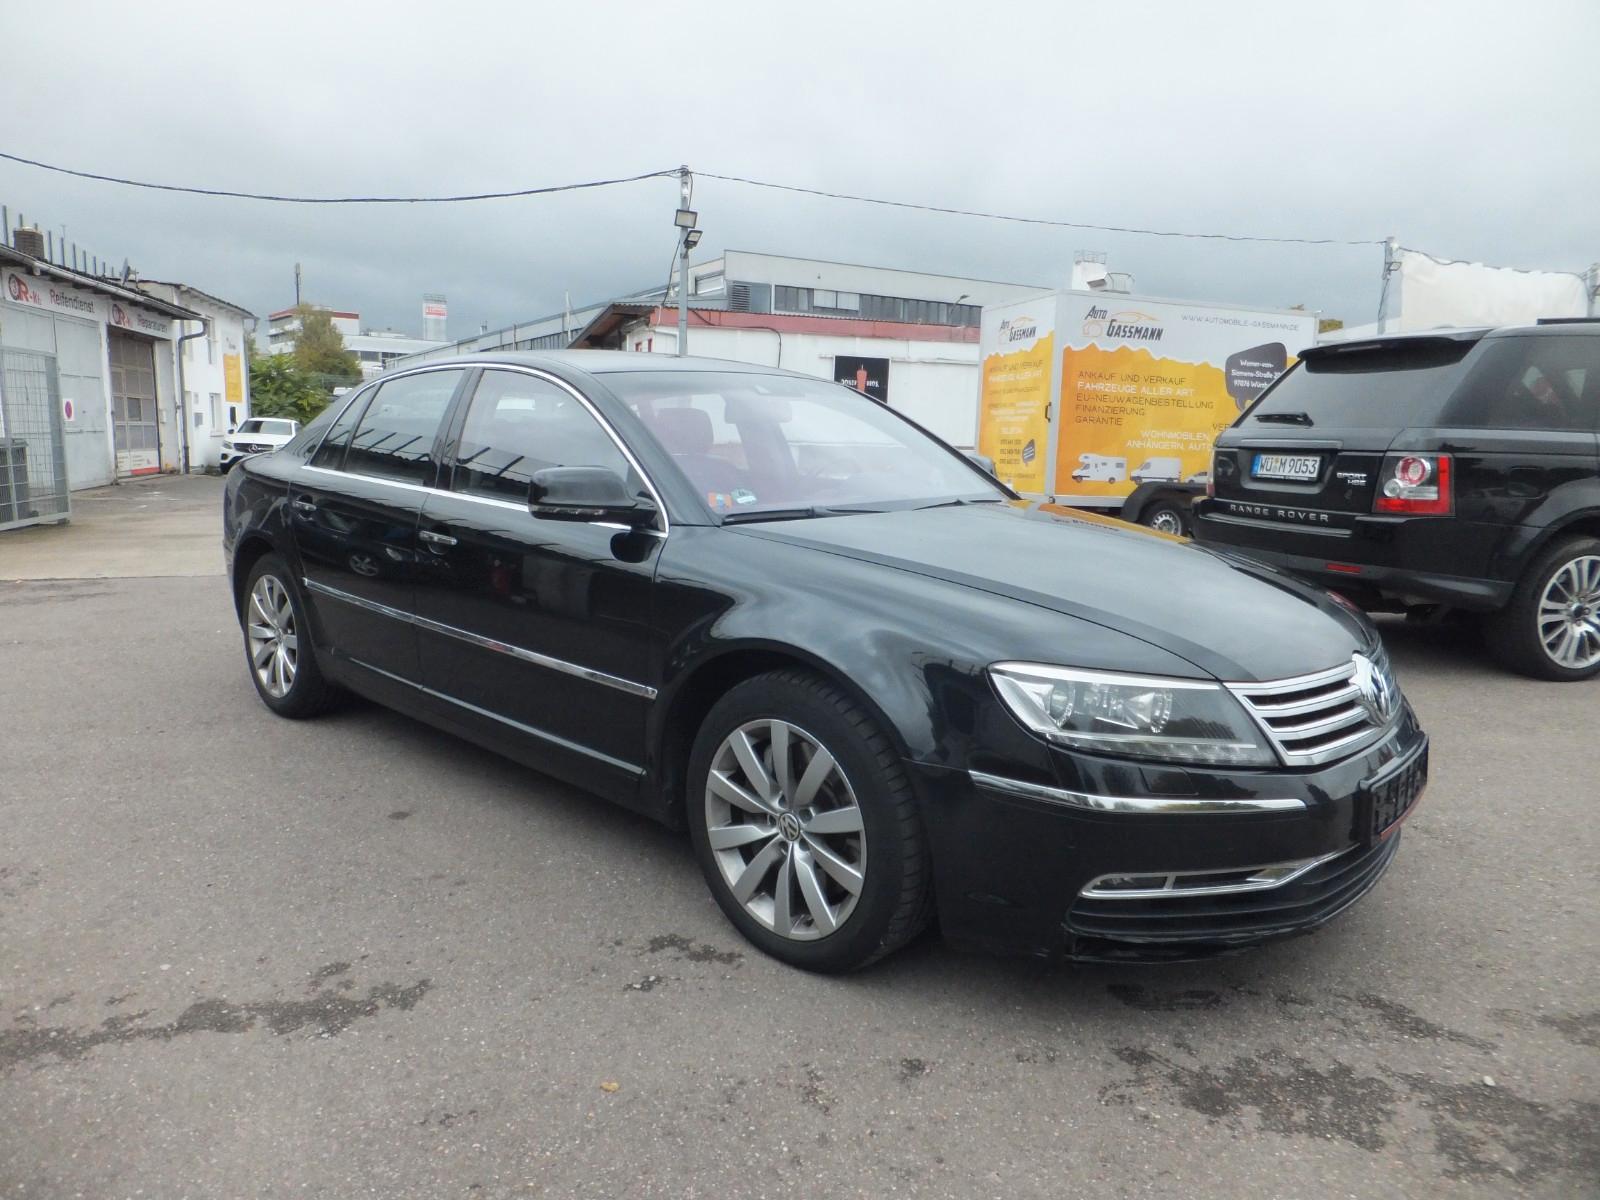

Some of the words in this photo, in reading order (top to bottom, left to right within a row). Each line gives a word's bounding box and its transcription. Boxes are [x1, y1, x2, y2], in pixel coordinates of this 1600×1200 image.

[49, 288, 95, 314] Reifendienst
[1085, 304, 1108, 320] AUTO
[1106, 319, 1164, 341] GASSMANN
[1078, 371, 1116, 381] ANKAUF
[1120, 374, 1140, 383] UND
[1143, 375, 1187, 385] VERKAUF
[1077, 381, 1137, 394] FAHRZEUGE
[1140, 385, 1173, 396] ALLER
[1175, 388, 1195, 397] ART
[1076, 393, 1214, 409] EU-NEUWAGENBESTELLUNG
[1075, 404, 1145, 416] FINANZIERUNG
[1075, 416, 1123, 426] GARANTIE
[1260, 457, 1274, 472] WÜ
[1279, 458, 1288, 473] M
[1288, 458, 1318, 474] 9053
[1230, 503, 1269, 516] RANGE
[1278, 509, 1329, 522] ROVER
